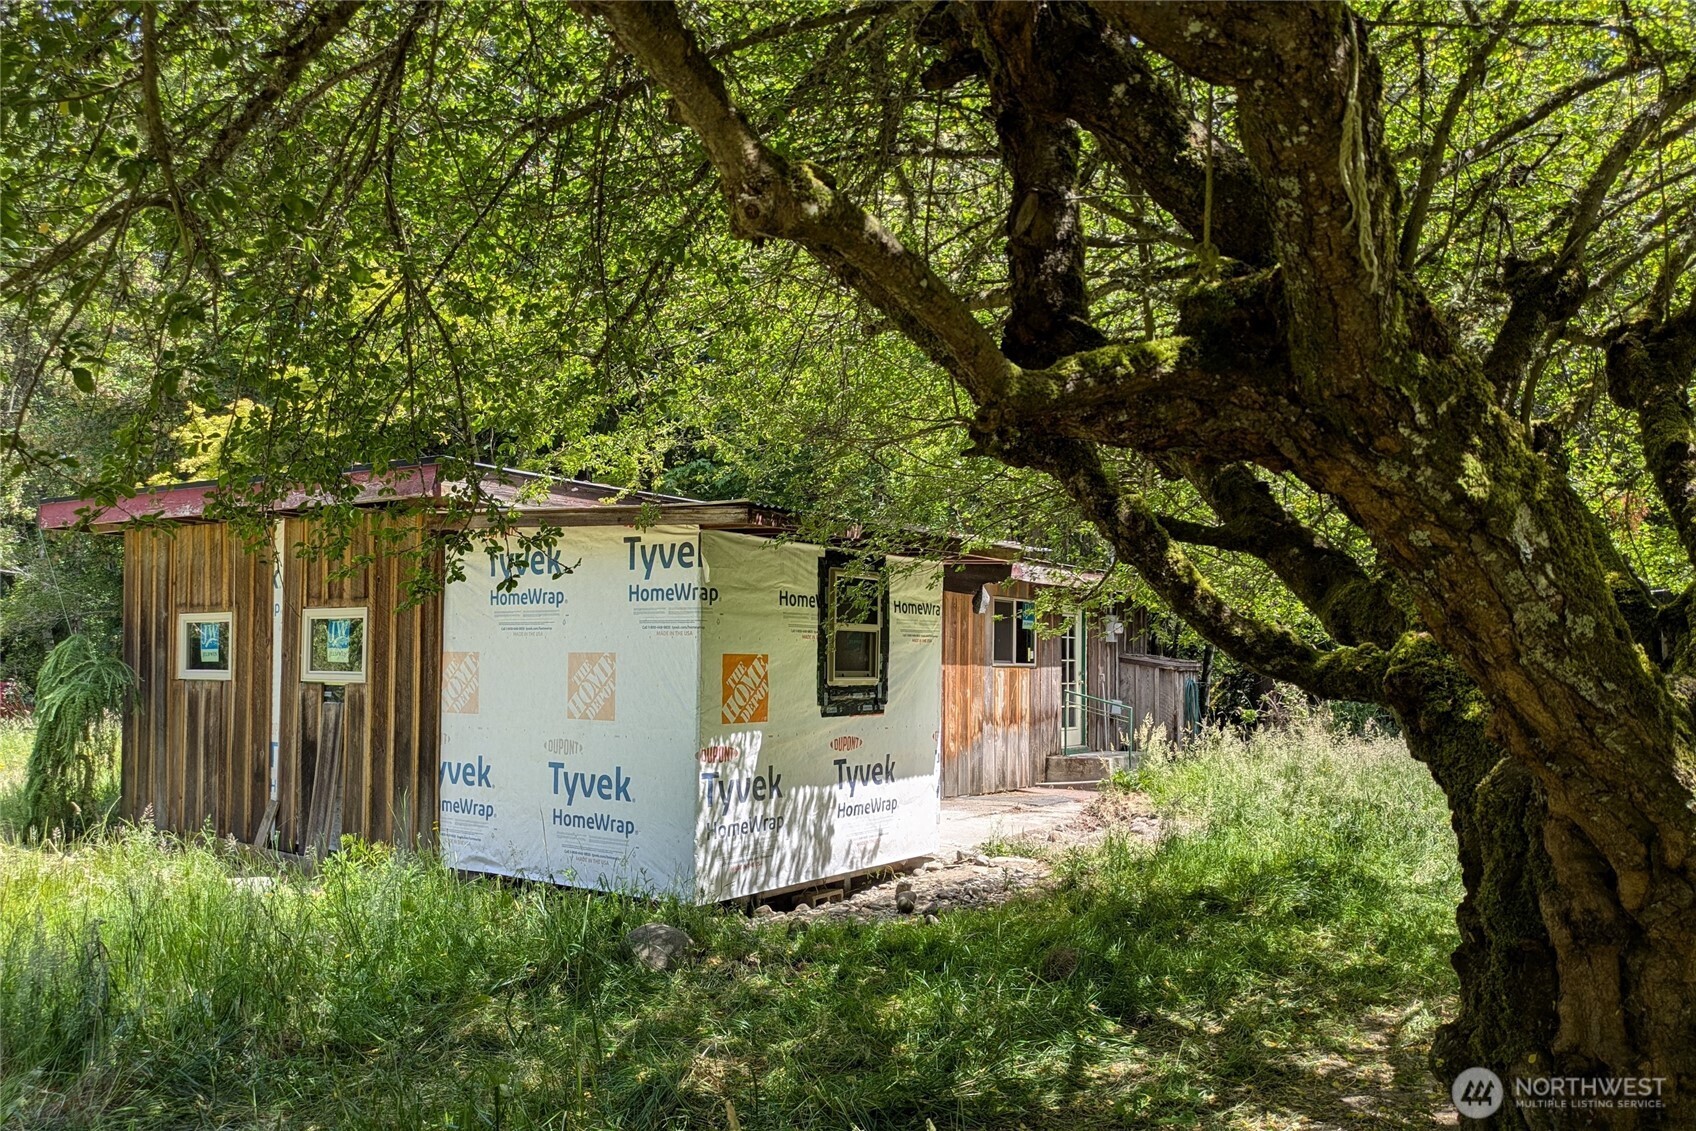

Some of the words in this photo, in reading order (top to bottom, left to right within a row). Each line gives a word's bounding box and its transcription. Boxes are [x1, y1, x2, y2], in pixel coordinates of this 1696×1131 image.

[490, 587, 565, 608] HomeWrap
[629, 583, 719, 606] HomeWrap
[568, 653, 616, 720] HOME
[572, 659, 593, 686] THE
[725, 661, 748, 690] THE
[585, 677, 616, 721] DEPOT
[722, 654, 769, 724] HOME
[740, 679, 769, 724] DEPOT
[548, 738, 579, 756] DUPONT
[701, 746, 735, 763] DUPONT
[833, 736, 860, 751] DUPONT
[548, 761, 632, 806] Tyvek
[833, 754, 896, 798] Tyvek
[701, 765, 783, 816] Tyvek
[441, 798, 494, 821] meWrap
[837, 797, 898, 819] HomeWrap
[552, 808, 635, 839] HomeWrap
[706, 812, 784, 840] HomeWrap
